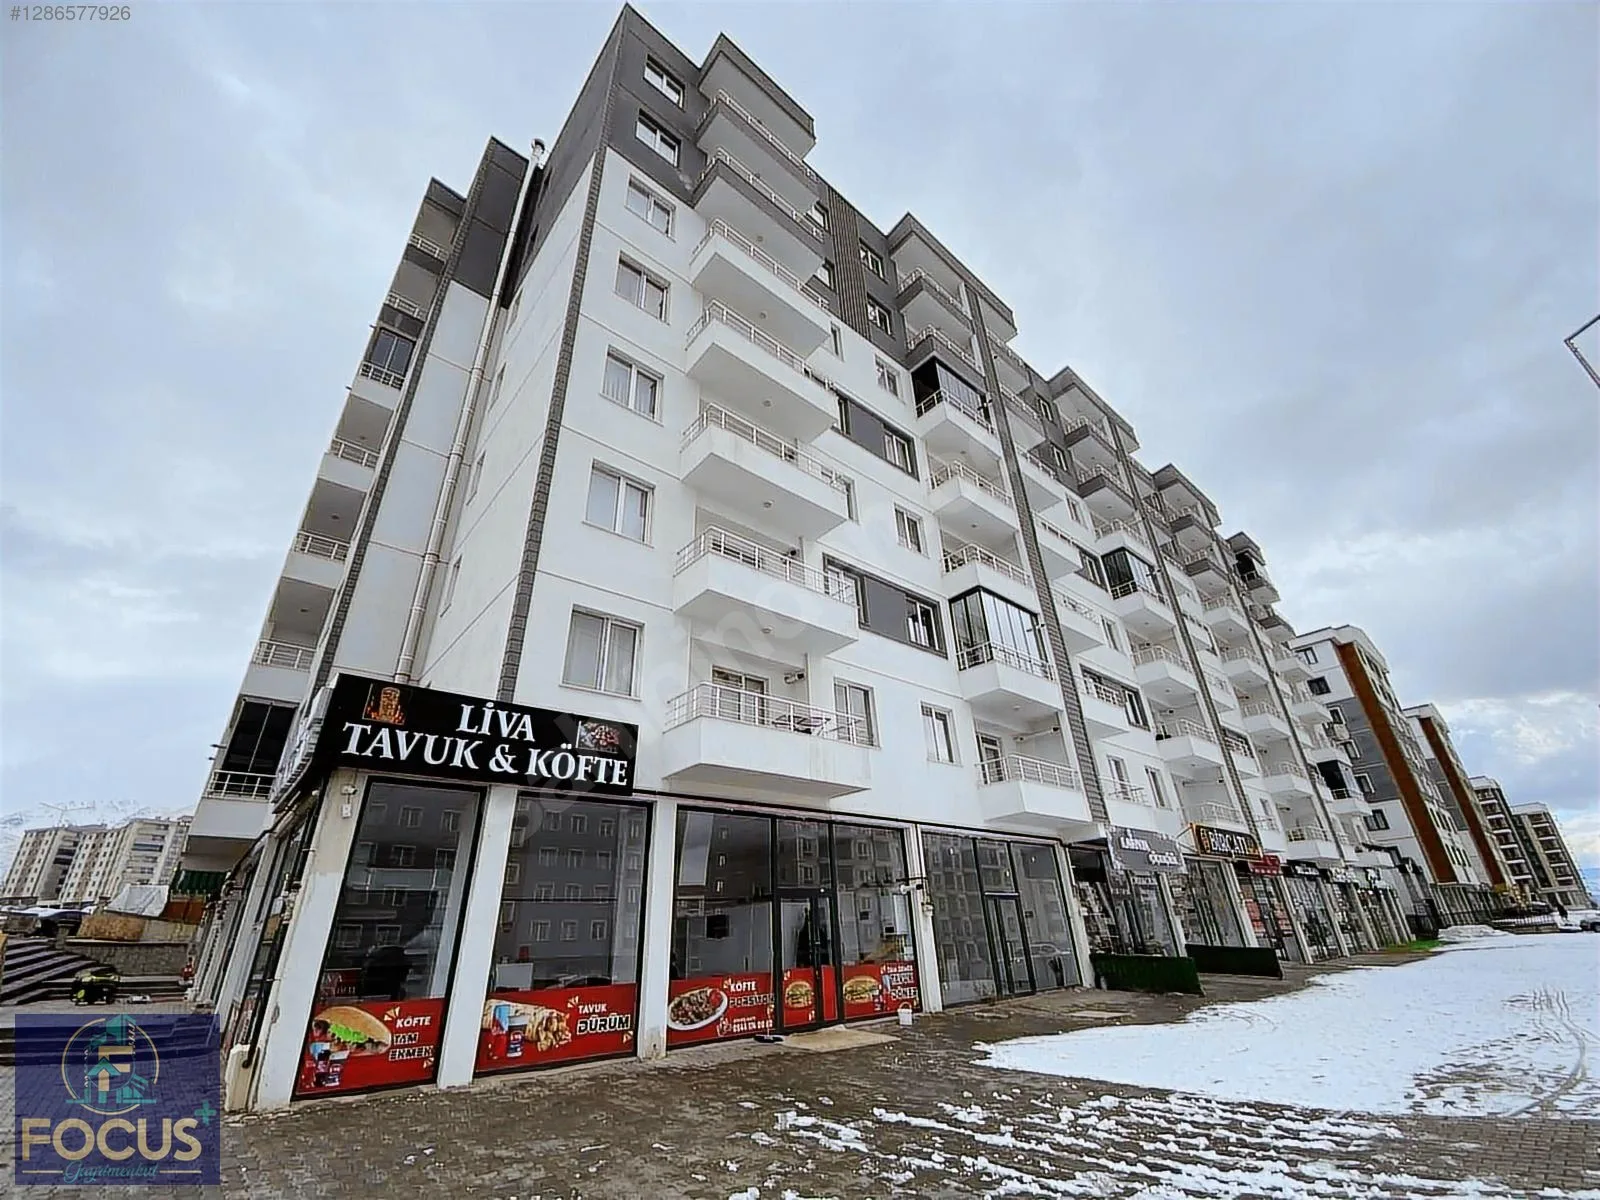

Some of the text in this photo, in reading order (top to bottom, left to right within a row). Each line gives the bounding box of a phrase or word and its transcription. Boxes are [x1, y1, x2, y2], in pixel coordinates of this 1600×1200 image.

[455, 701, 536, 742] LİVA
[341, 721, 483, 770] TAVUK
[488, 743, 519, 774] &
[524, 742, 628, 787] KÖFTE
[578, 1003, 608, 1014] TAVUK
[396, 1015, 431, 1028] KÖFTE
[577, 1012, 631, 1035] DÜRÜM
[393, 1032, 419, 1046] TAM
[388, 1045, 434, 1062] EKMEK
